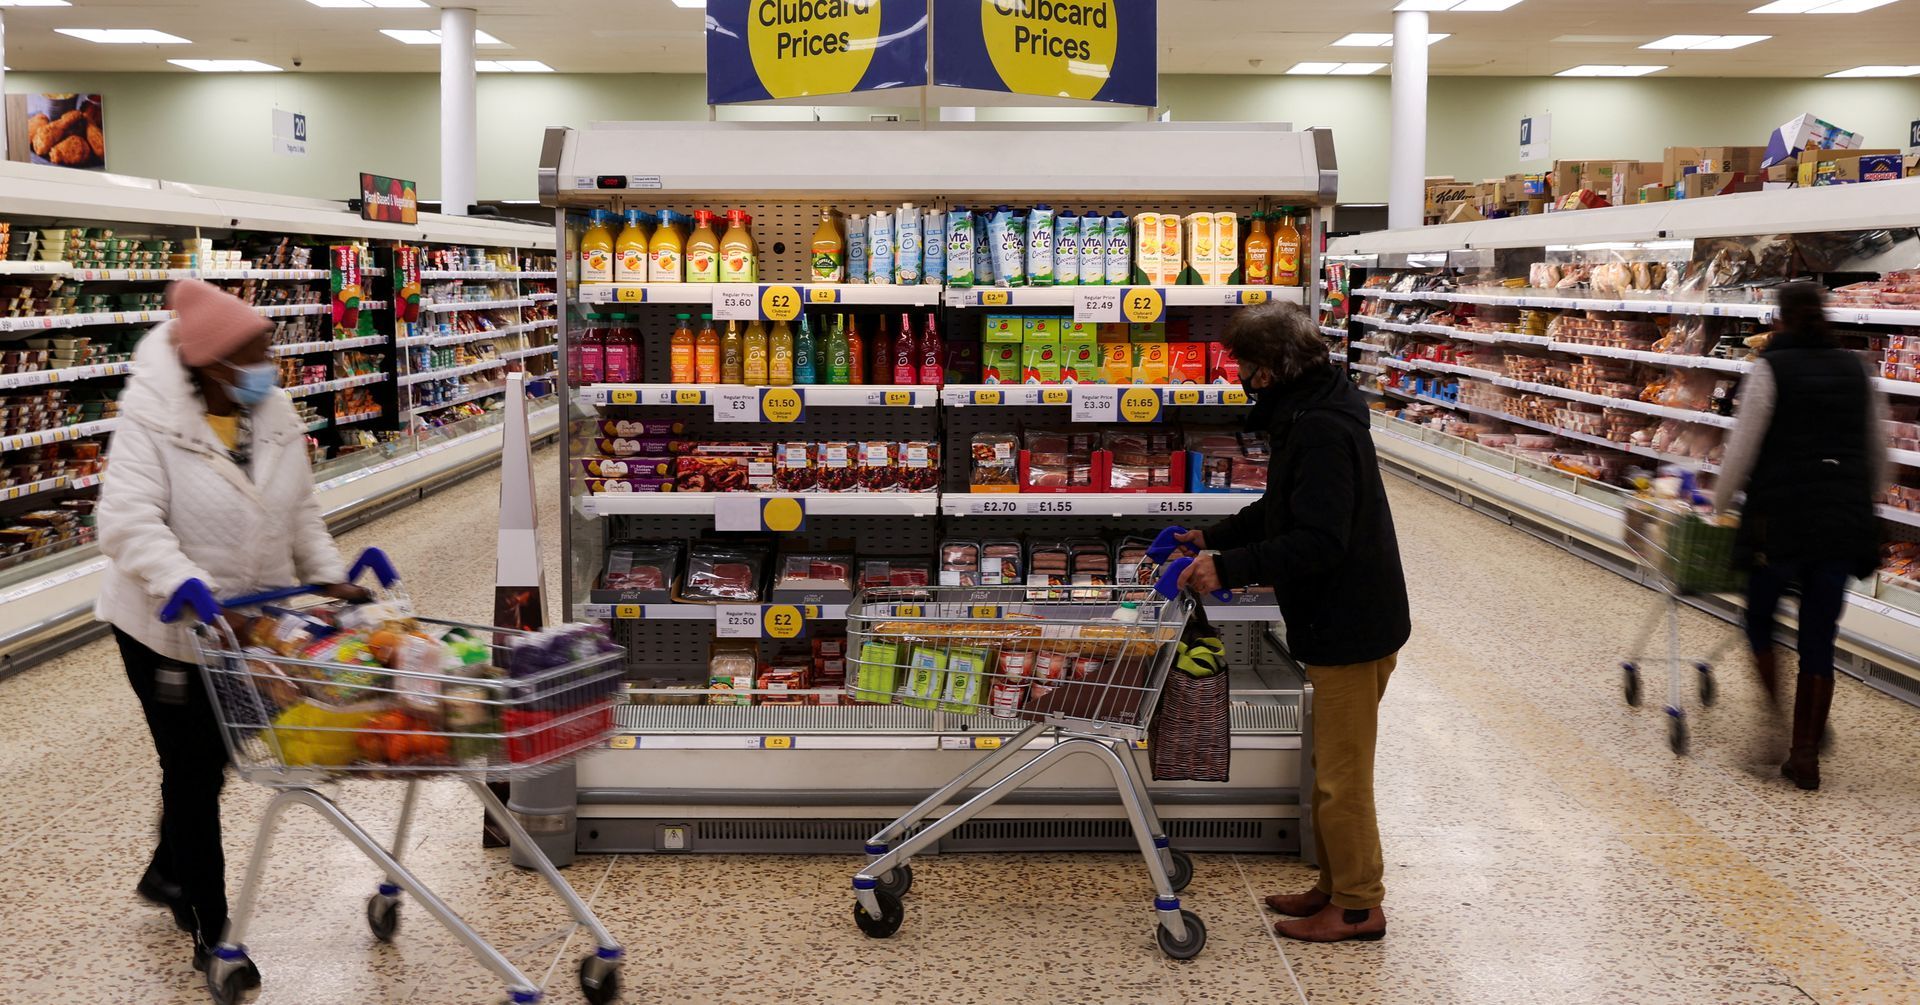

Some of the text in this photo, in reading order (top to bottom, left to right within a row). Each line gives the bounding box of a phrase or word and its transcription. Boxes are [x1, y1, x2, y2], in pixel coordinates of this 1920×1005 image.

[777, 29, 850, 59] Prices
[1015, 25, 1091, 60] Prices
[295, 117, 305, 137] 20
[949, 232, 969, 242] VITA
[1032, 230, 1051, 240] VITA
[948, 242, 972, 250] COCO
[977, 237, 987, 247] VI
[1031, 240, 1051, 248] COC
[1057, 237, 1077, 247] VITA
[1082, 237, 1102, 247] VITA
[1107, 237, 1128, 247] VITA
[976, 246, 989, 255] CO
[1056, 247, 1078, 255] COCO
[1081, 247, 1104, 255] COCO
[1106, 247, 1129, 255] COCO
[348, 249, 356, 287] Vegetarian
[625, 290, 635, 298] £2
[724, 298, 752, 307] £3.60
[772, 295, 790, 308] £2
[1086, 301, 1113, 310] £2.49
[1134, 297, 1151, 310] £2
[732, 400, 746, 410] £3
[768, 399, 795, 408] £1.50
[1084, 401, 1111, 409] £3.30
[1126, 399, 1153, 407] £1.65
[983, 501, 1017, 512] £2.70
[1040, 501, 1072, 512] £1.55
[1160, 501, 1193, 512] £1.55
[619, 592, 639, 601] finest
[968, 591, 988, 601] finest
[728, 617, 755, 626] £2.50
[774, 614, 792, 626] £2
